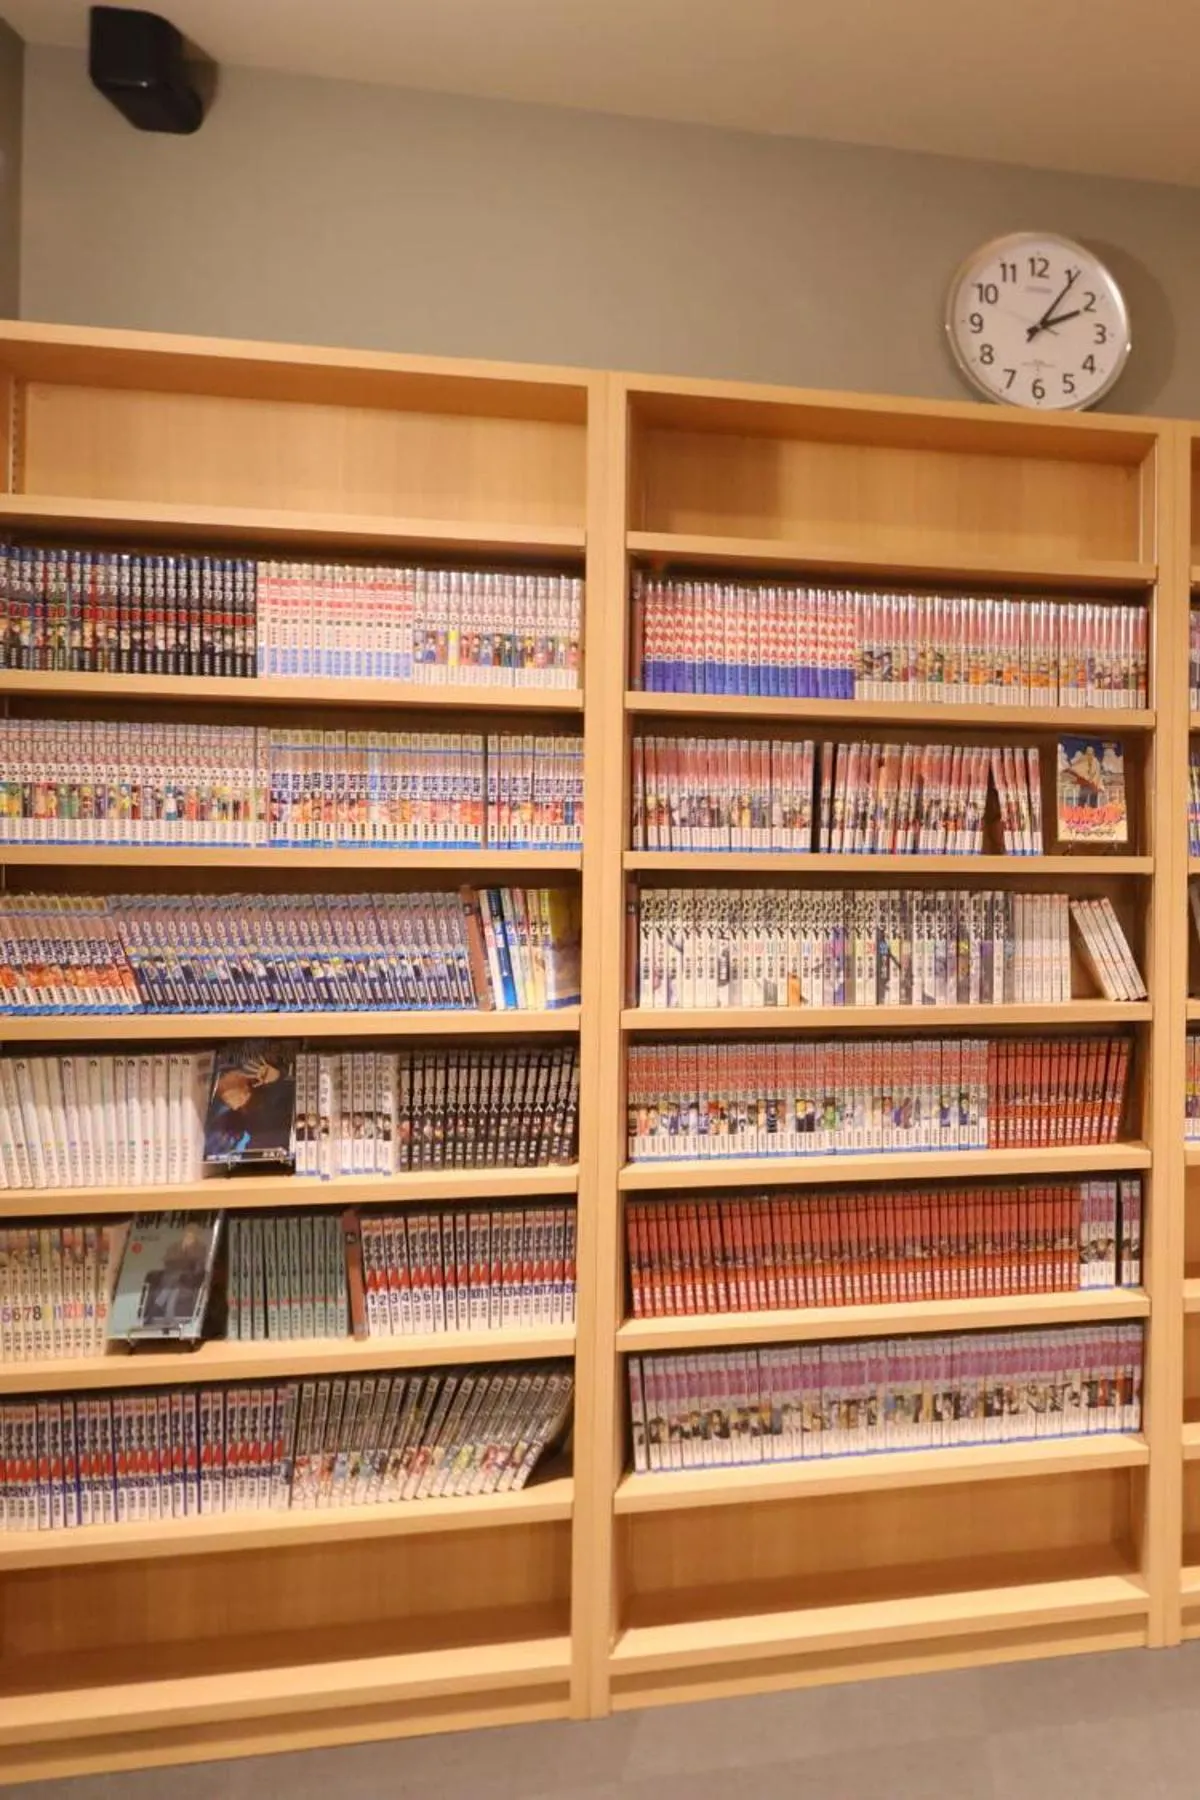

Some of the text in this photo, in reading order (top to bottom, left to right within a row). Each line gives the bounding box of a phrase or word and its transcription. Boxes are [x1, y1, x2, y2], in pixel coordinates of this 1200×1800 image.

[1000, 263, 1017, 283] 11
[1028, 257, 1050, 279] 12
[976, 283, 999, 305] 10
[1083, 292, 1097, 313] 2
[969, 312, 984, 334] 9
[1093, 323, 1107, 345] 3
[979, 344, 995, 365] 8
[1081, 354, 1096, 375] 4
[1003, 368, 1017, 390] 7
[1031, 379, 1045, 400] 6
[1062, 373, 1075, 394] 5
